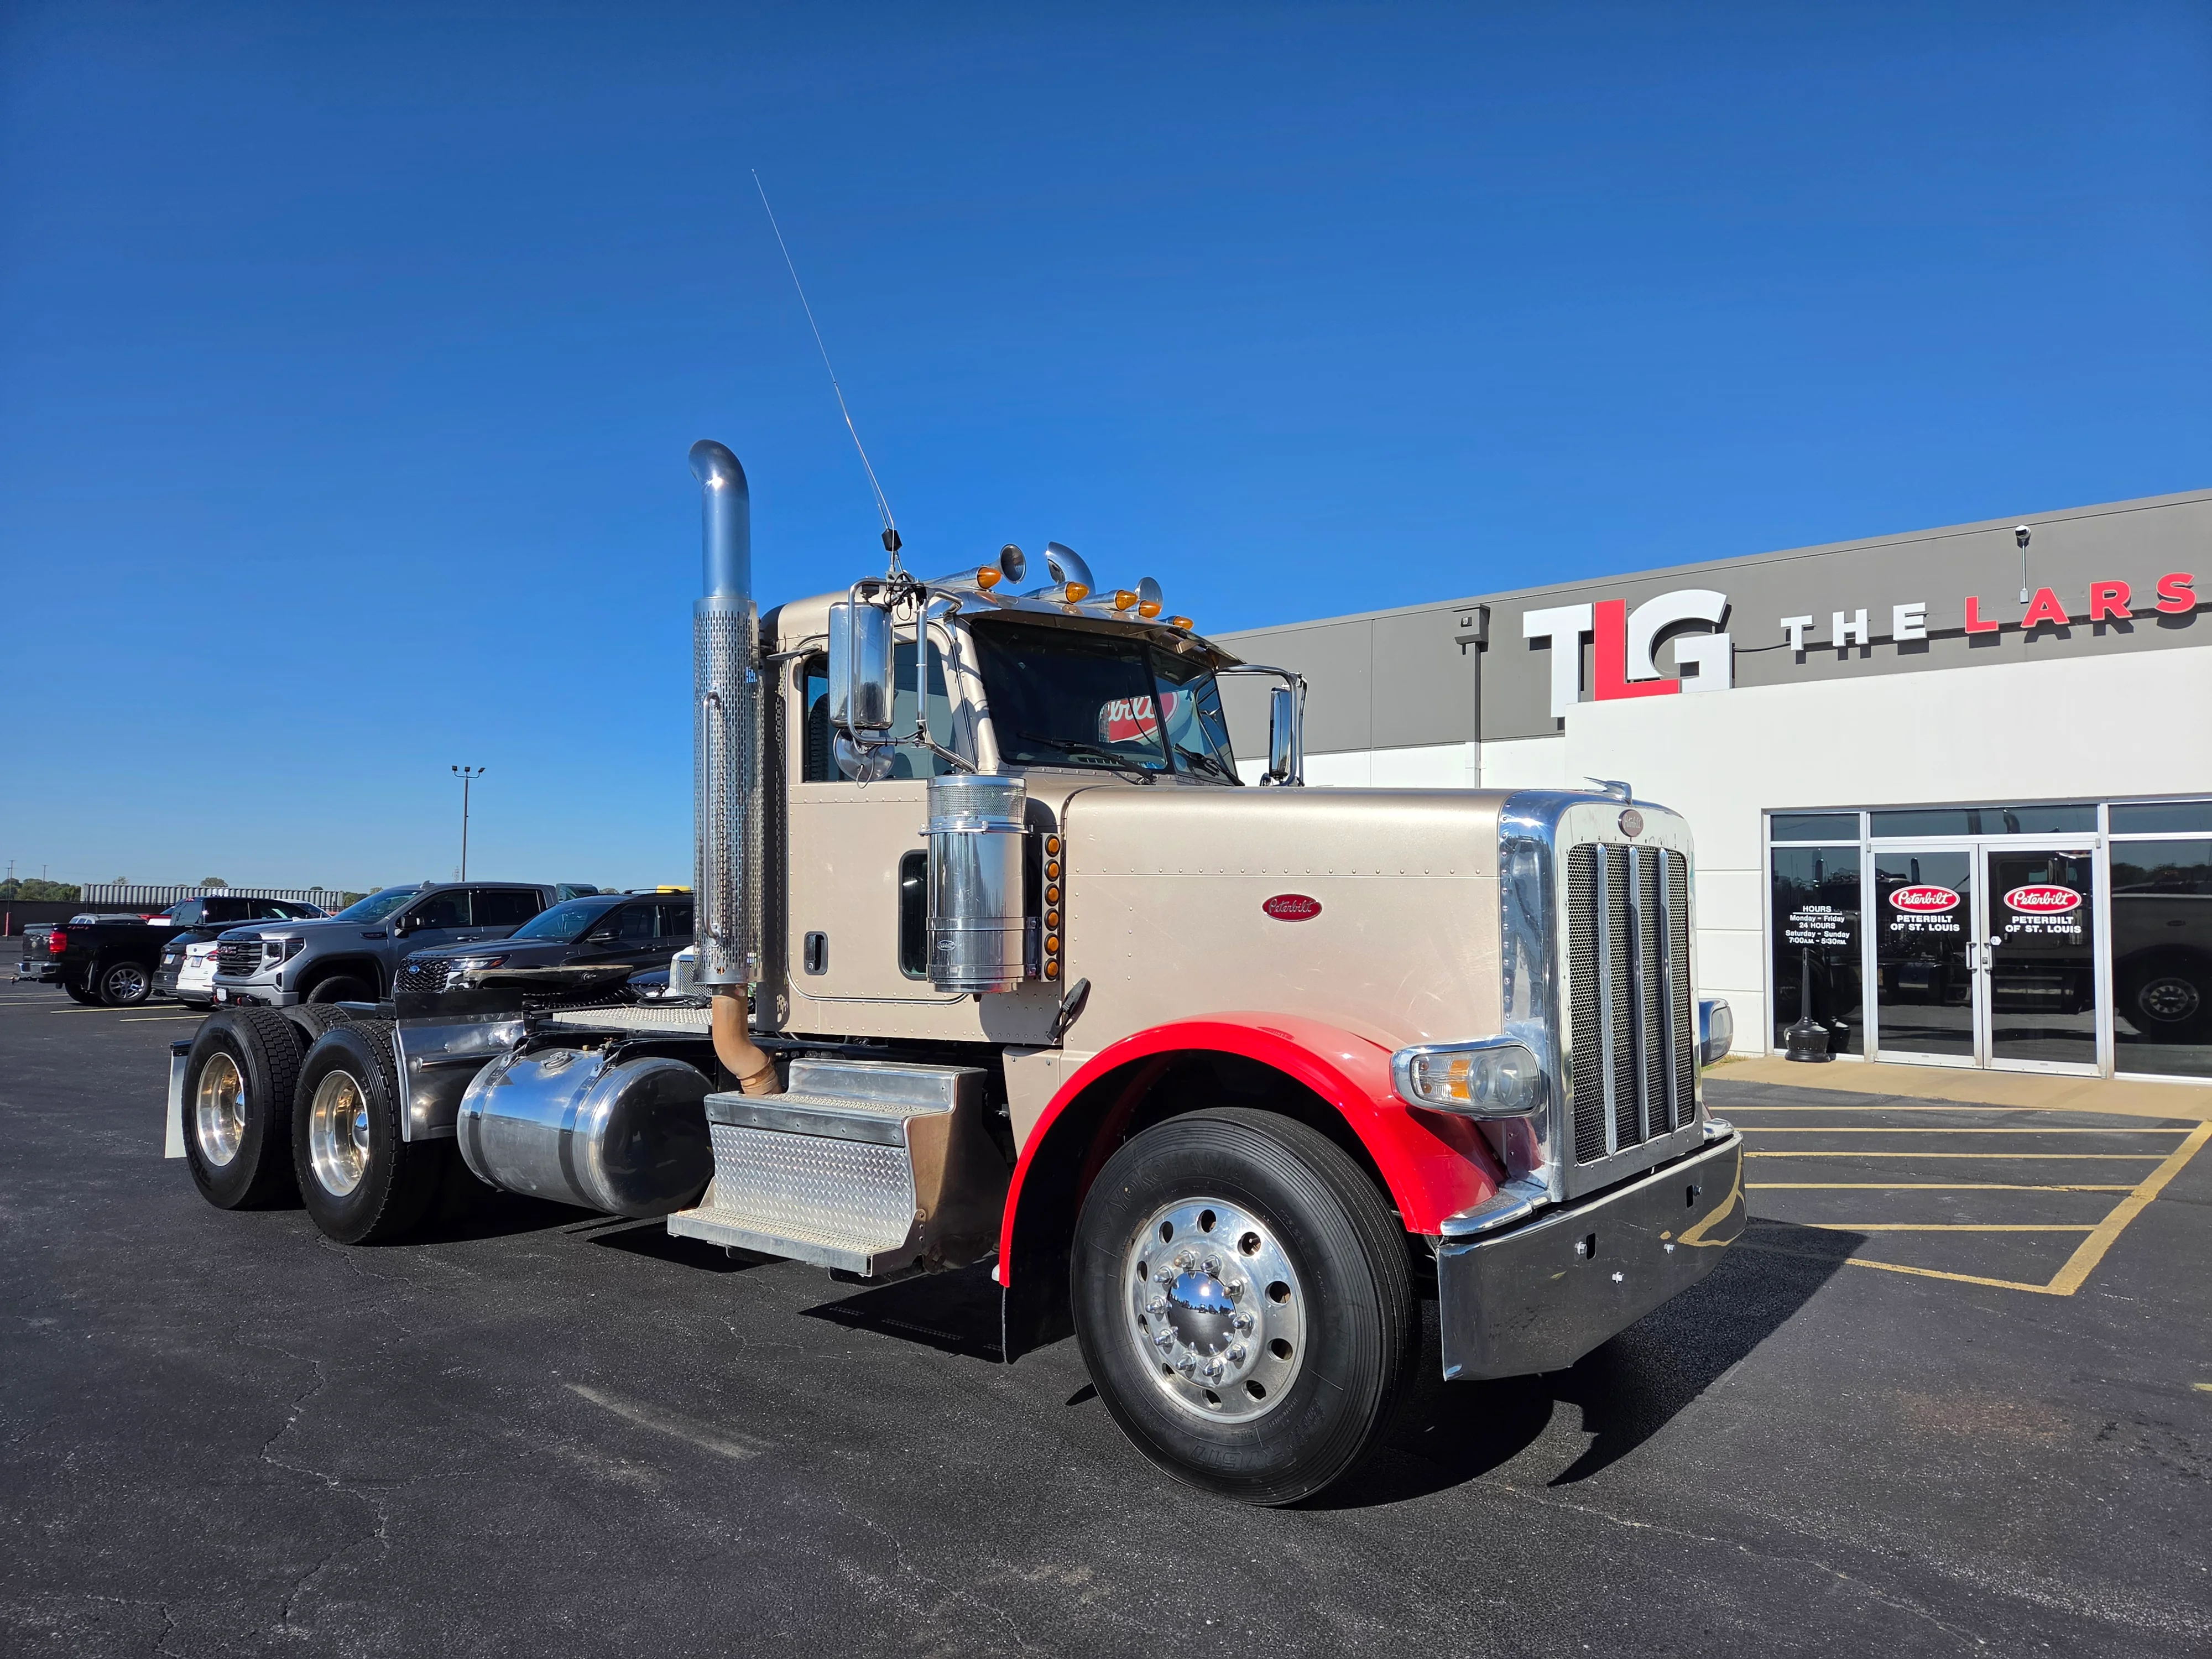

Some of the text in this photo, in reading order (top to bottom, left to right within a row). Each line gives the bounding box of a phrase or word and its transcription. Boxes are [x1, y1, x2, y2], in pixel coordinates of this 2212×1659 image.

[1781, 572, 2198, 651] THE LARS
[1523, 589, 1730, 718] TLG
[1898, 891, 1953, 905] Peterbilt
[2013, 891, 2073, 906] Peterbilt
[1269, 899, 1316, 914] Peterbilt
[1897, 915, 1953, 923] PETERBILT
[2012, 916, 2074, 925] PETERBILT
[1908, 923, 1924, 931] ST.
[2025, 925, 2043, 933] ST.
[2047, 925, 2081, 933] LOUIS
